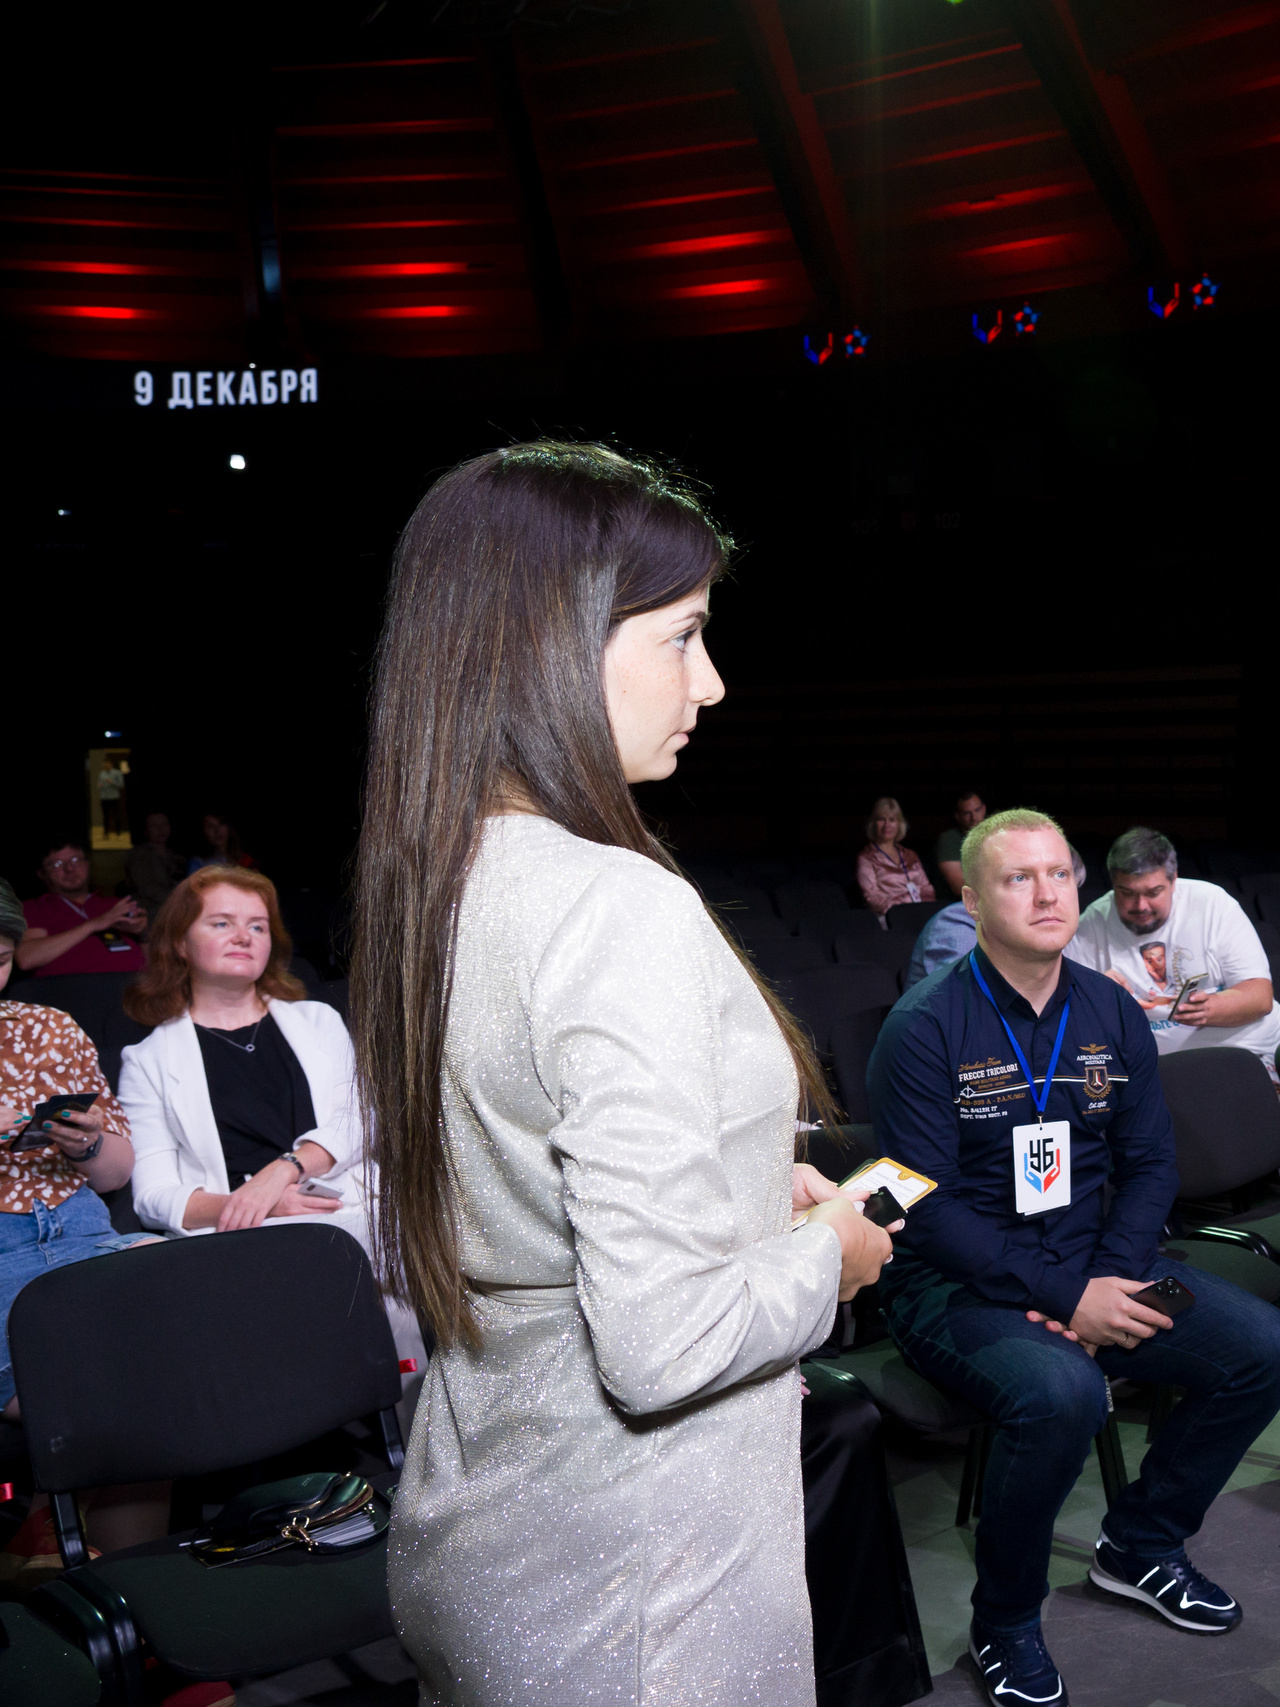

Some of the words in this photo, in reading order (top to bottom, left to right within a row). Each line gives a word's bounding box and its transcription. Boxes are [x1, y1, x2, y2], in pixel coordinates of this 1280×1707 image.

[134, 370, 154, 406] 9
[167, 368, 318, 410] ДЕКАБРЯ
[958, 1069, 985, 1082] FRECCE
[986, 1063, 1018, 1076] TRICOLORI
